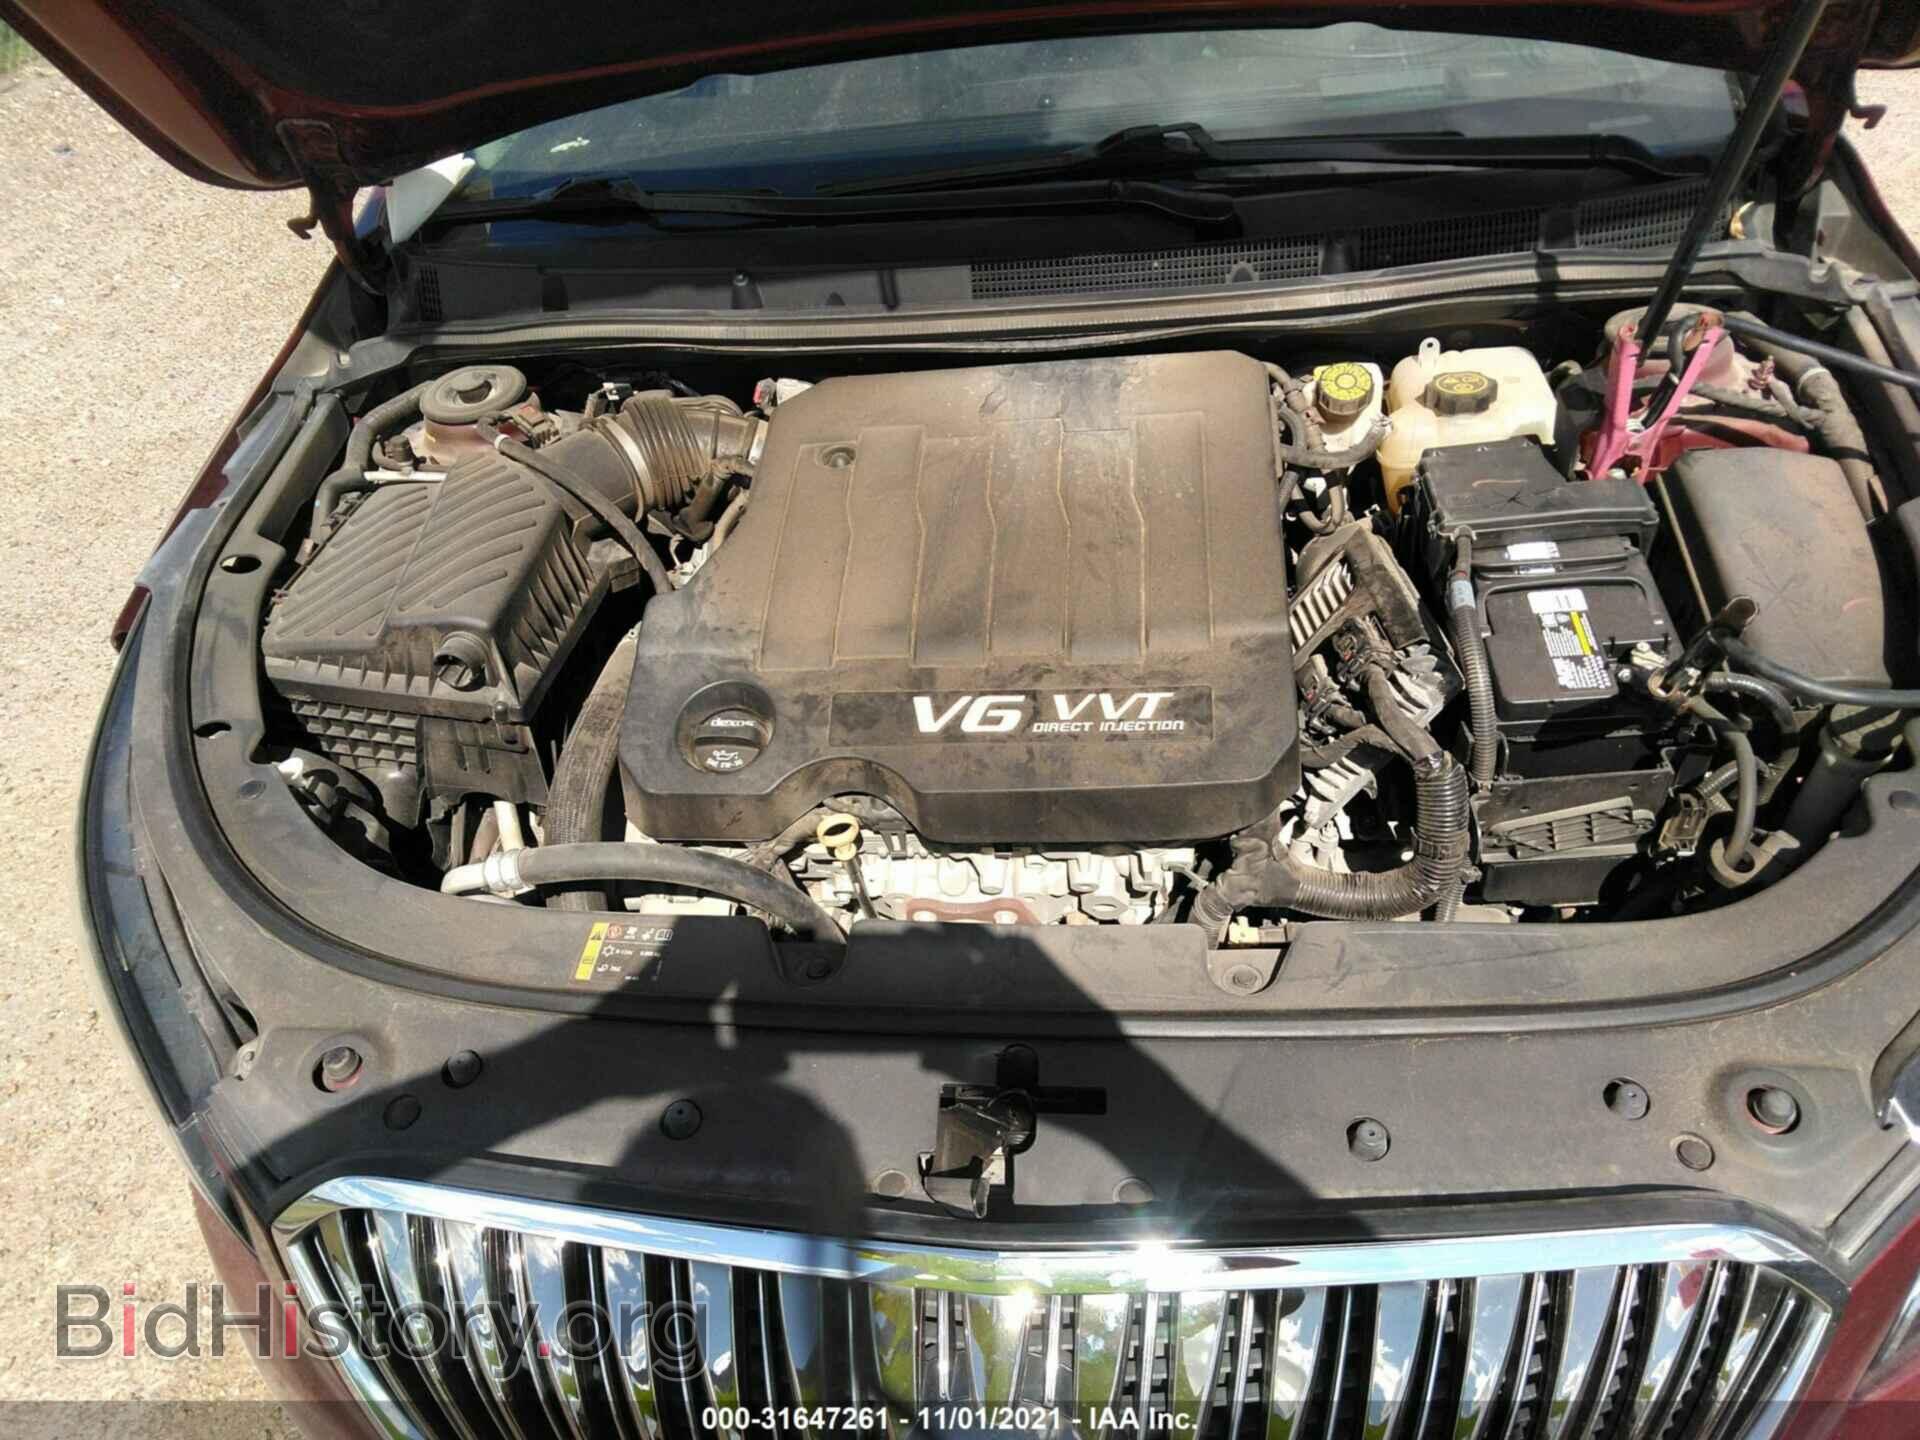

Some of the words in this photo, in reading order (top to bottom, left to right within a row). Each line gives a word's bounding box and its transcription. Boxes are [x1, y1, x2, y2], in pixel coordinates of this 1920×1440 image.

[913, 694, 1026, 733] V6
[1053, 691, 1175, 720] VVT
[1032, 721, 1094, 732] DIRECT
[1099, 719, 1185, 731] INJECTION
